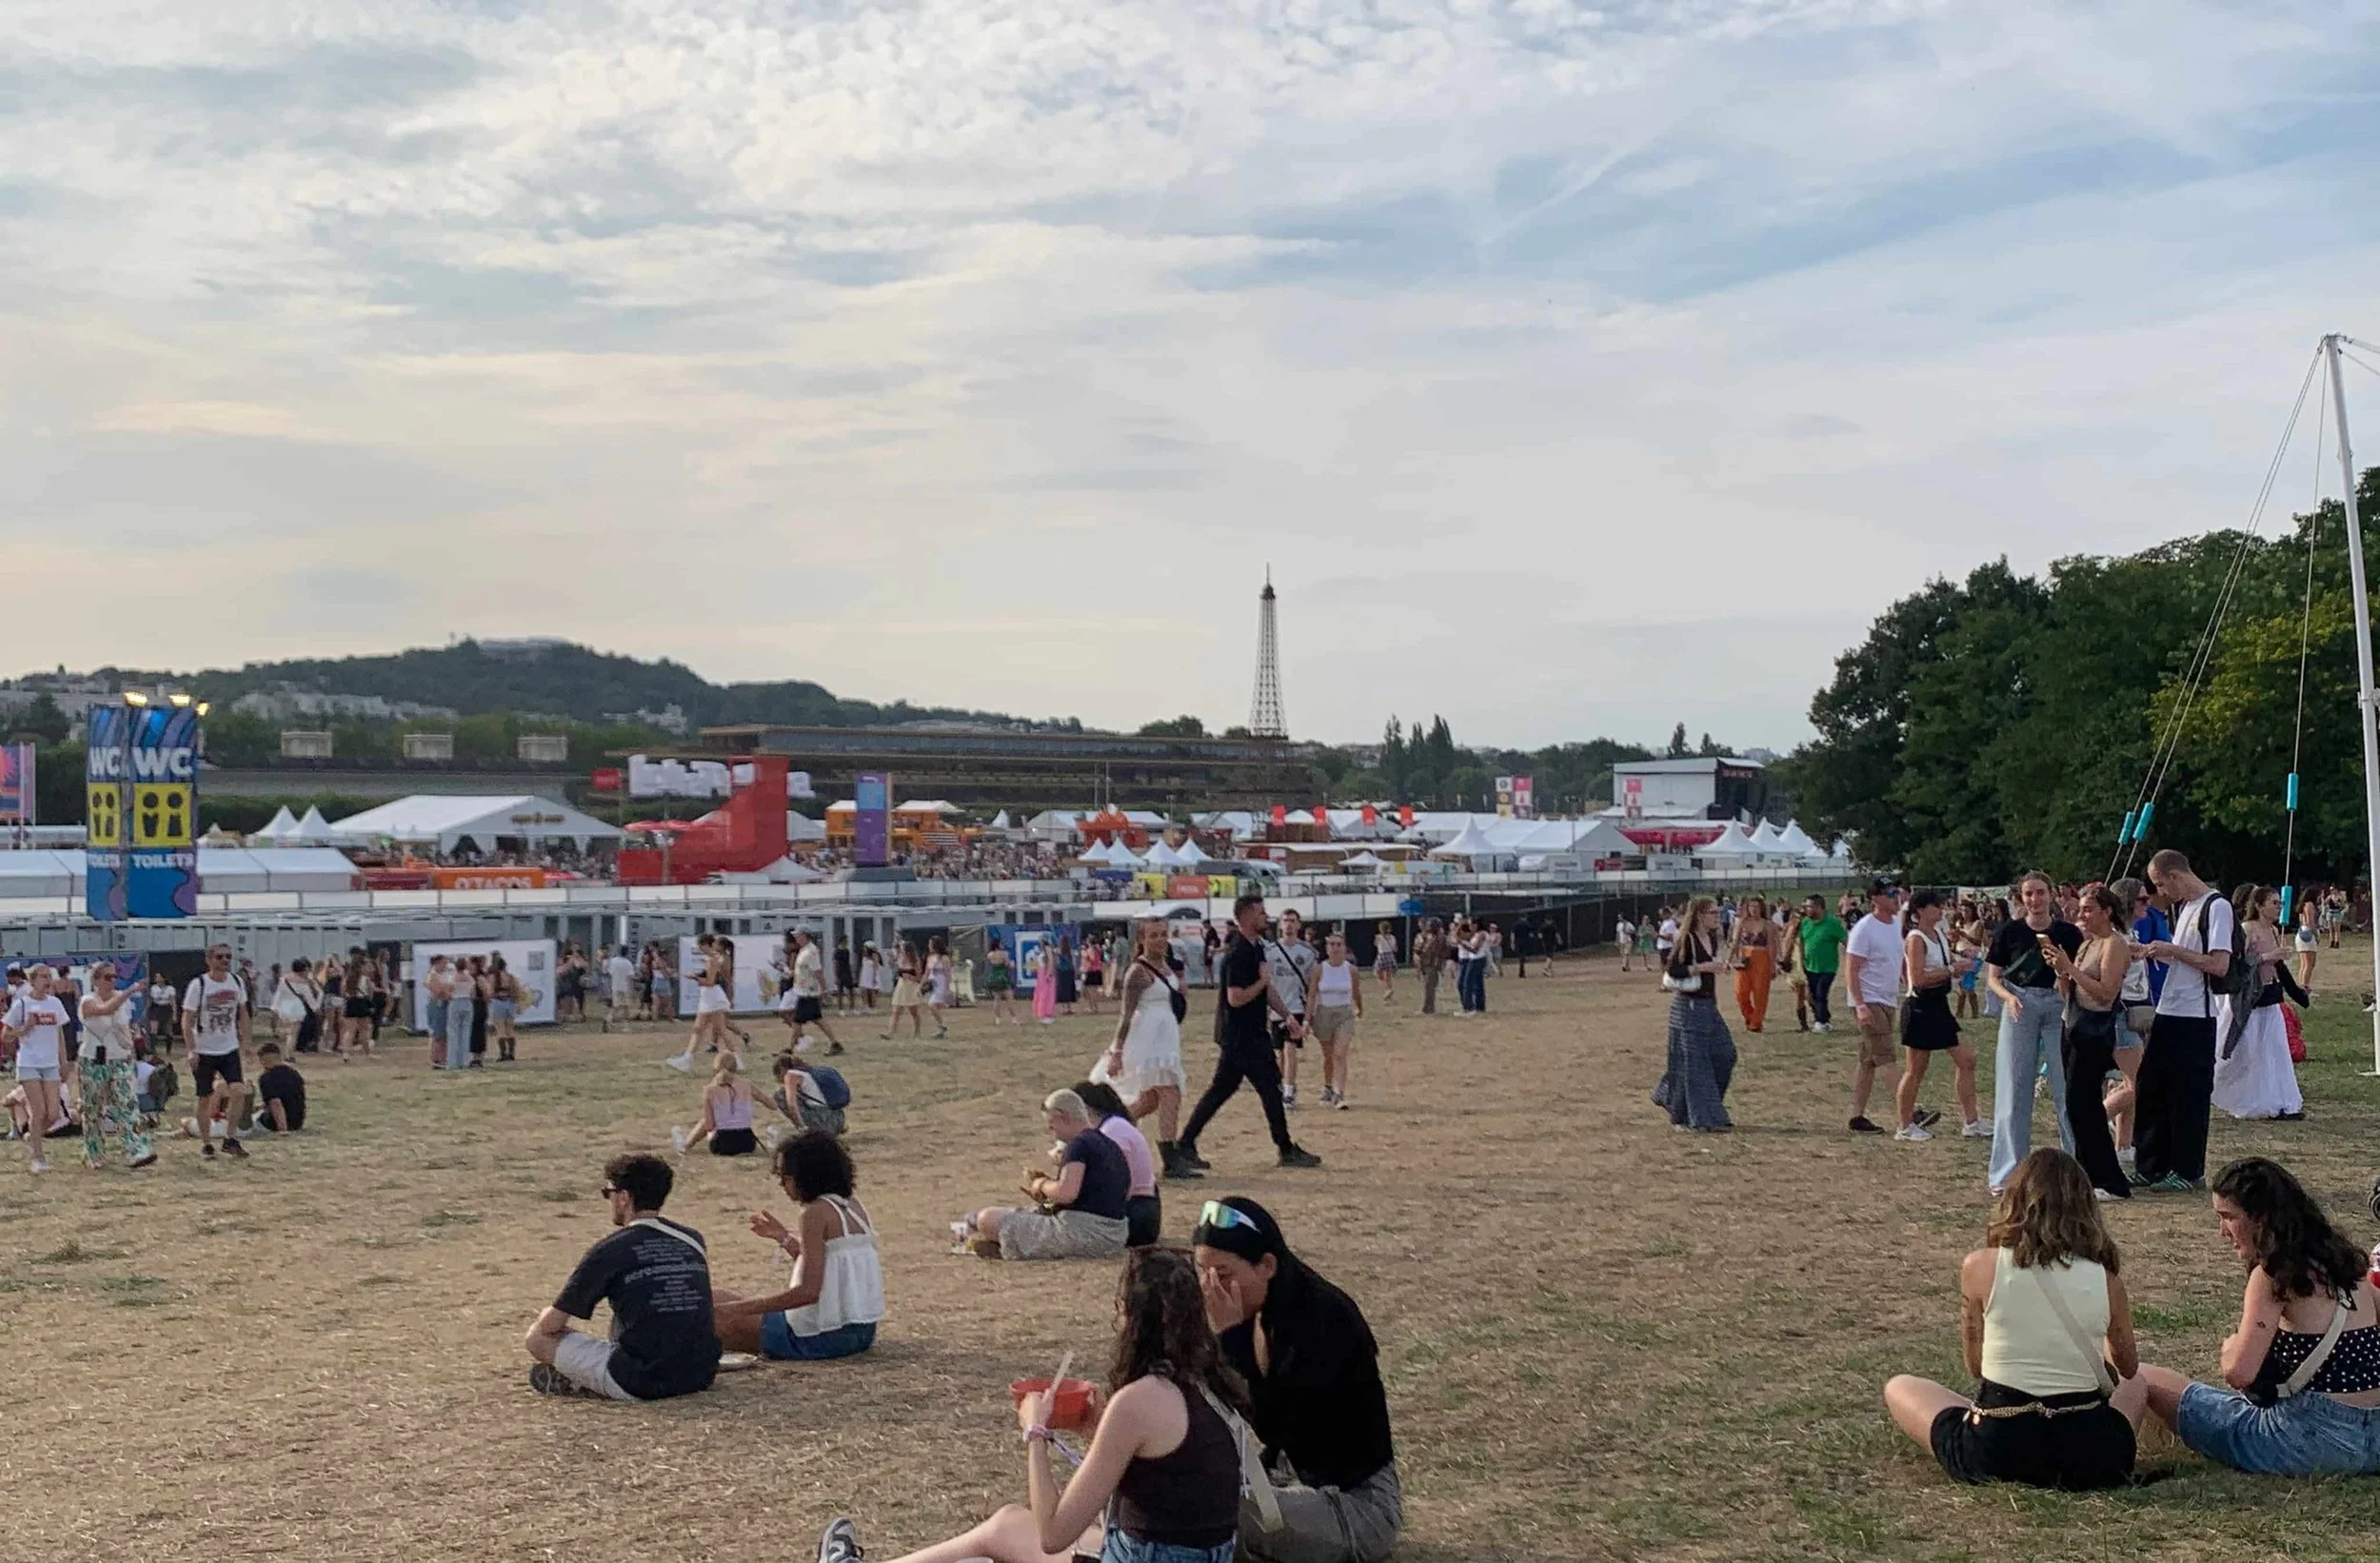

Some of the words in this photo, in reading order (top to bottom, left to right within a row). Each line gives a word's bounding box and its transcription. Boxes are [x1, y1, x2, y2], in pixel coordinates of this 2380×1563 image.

[89, 746, 121, 777] WC
[132, 746, 193, 778] WC
[132, 854, 194, 869] TOILETS
